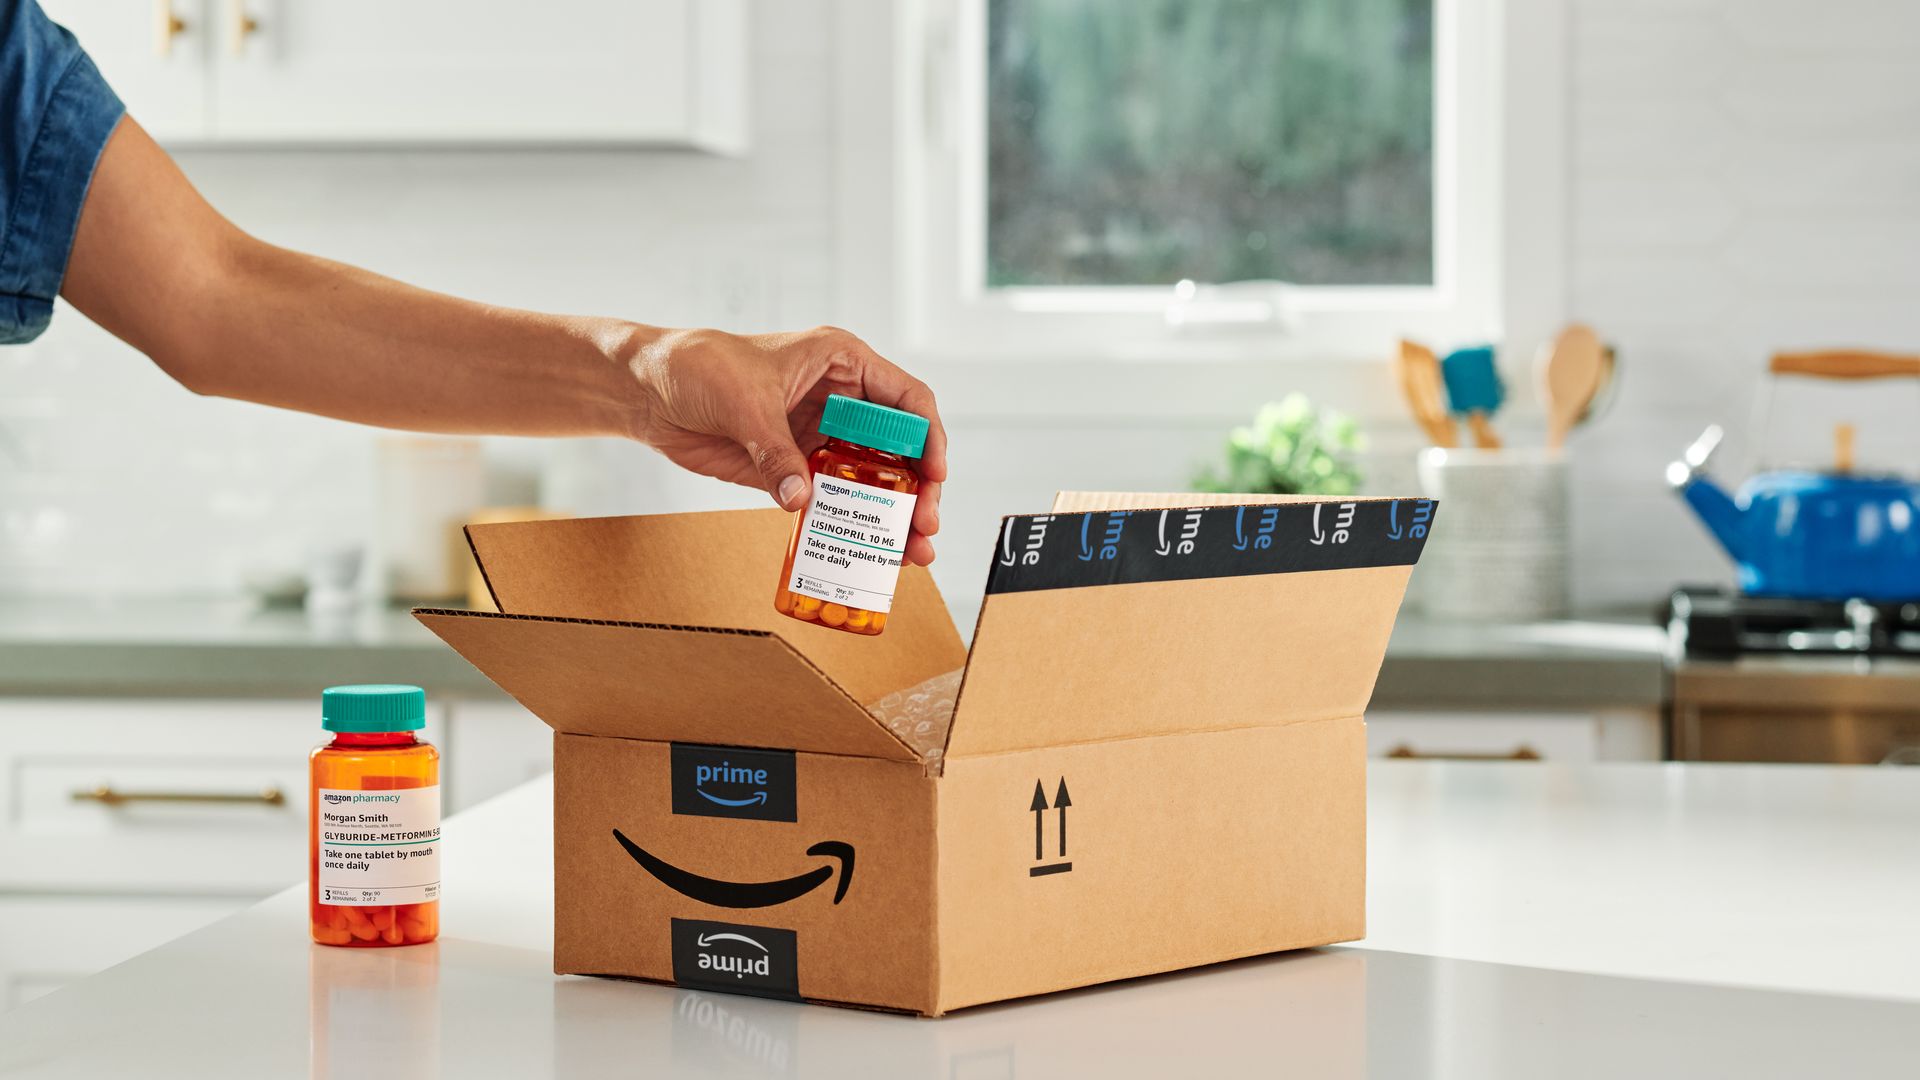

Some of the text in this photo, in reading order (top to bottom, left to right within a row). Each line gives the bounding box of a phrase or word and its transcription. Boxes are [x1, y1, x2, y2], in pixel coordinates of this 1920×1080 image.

[820, 482, 896, 508] amazon pharmacy
[815, 500, 881, 524] Morgan Smith
[811, 519, 895, 547] LISINOPRIL 10 MG
[1022, 516, 1056, 565] ime
[1099, 512, 1133, 560] ime
[804, 549, 851, 569] once daily
[807, 537, 826, 550] Take
[827, 544, 846, 555] one
[848, 549, 876, 563] tablet
[878, 555, 888, 566] by
[796, 577, 803, 588] 3
[804, 585, 830, 596] REMAINING
[696, 761, 768, 786] prime
[324, 794, 400, 804] amazon pharmacy
[324, 813, 389, 823] Morgan Smith
[324, 829, 432, 841] GLYBURIDE-METFORMIN
[325, 849, 343, 859] Take
[365, 850, 395, 859] tablet
[397, 850, 408, 860] by
[410, 847, 433, 858] mouth
[325, 861, 370, 871] once daily
[325, 889, 331, 900] 3
[698, 953, 769, 979] prime
